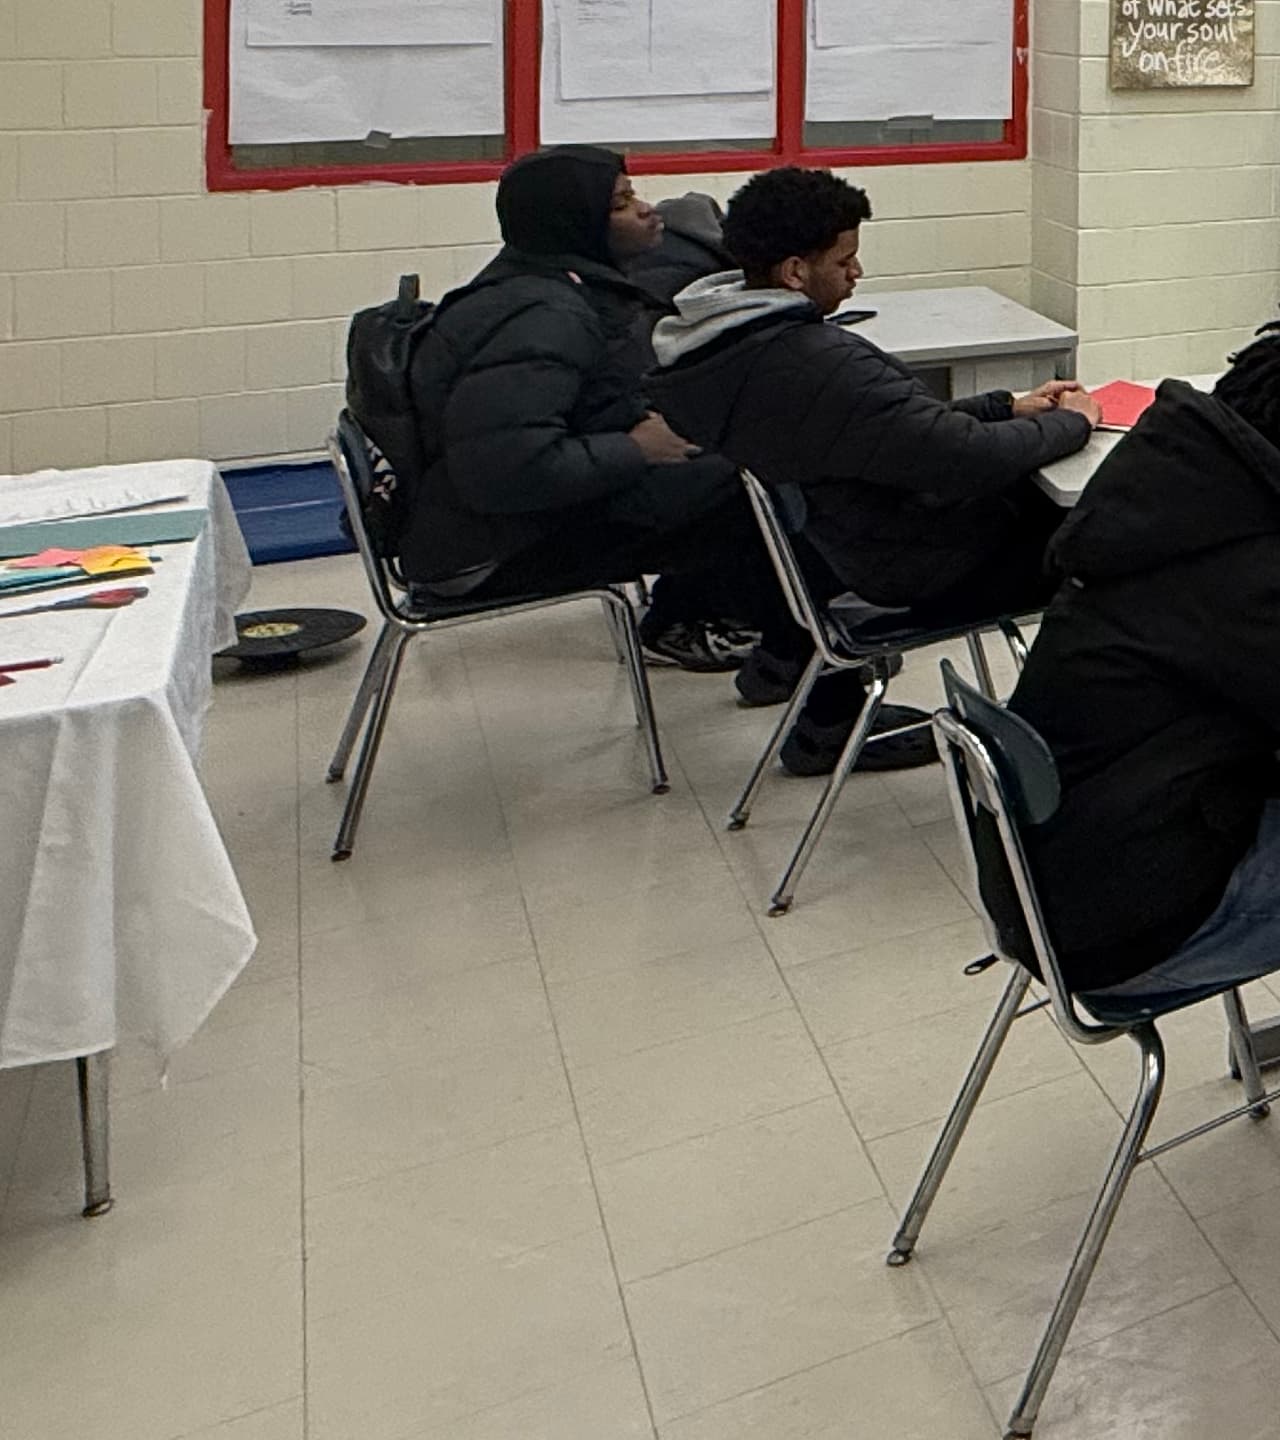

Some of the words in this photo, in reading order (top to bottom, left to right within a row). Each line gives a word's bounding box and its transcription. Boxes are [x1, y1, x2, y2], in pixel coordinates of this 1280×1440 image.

[1121, 19, 1184, 58] your
[1186, 17, 1238, 44] soul
[1138, 49, 1169, 72] on
[1169, 39, 1227, 82] fire
